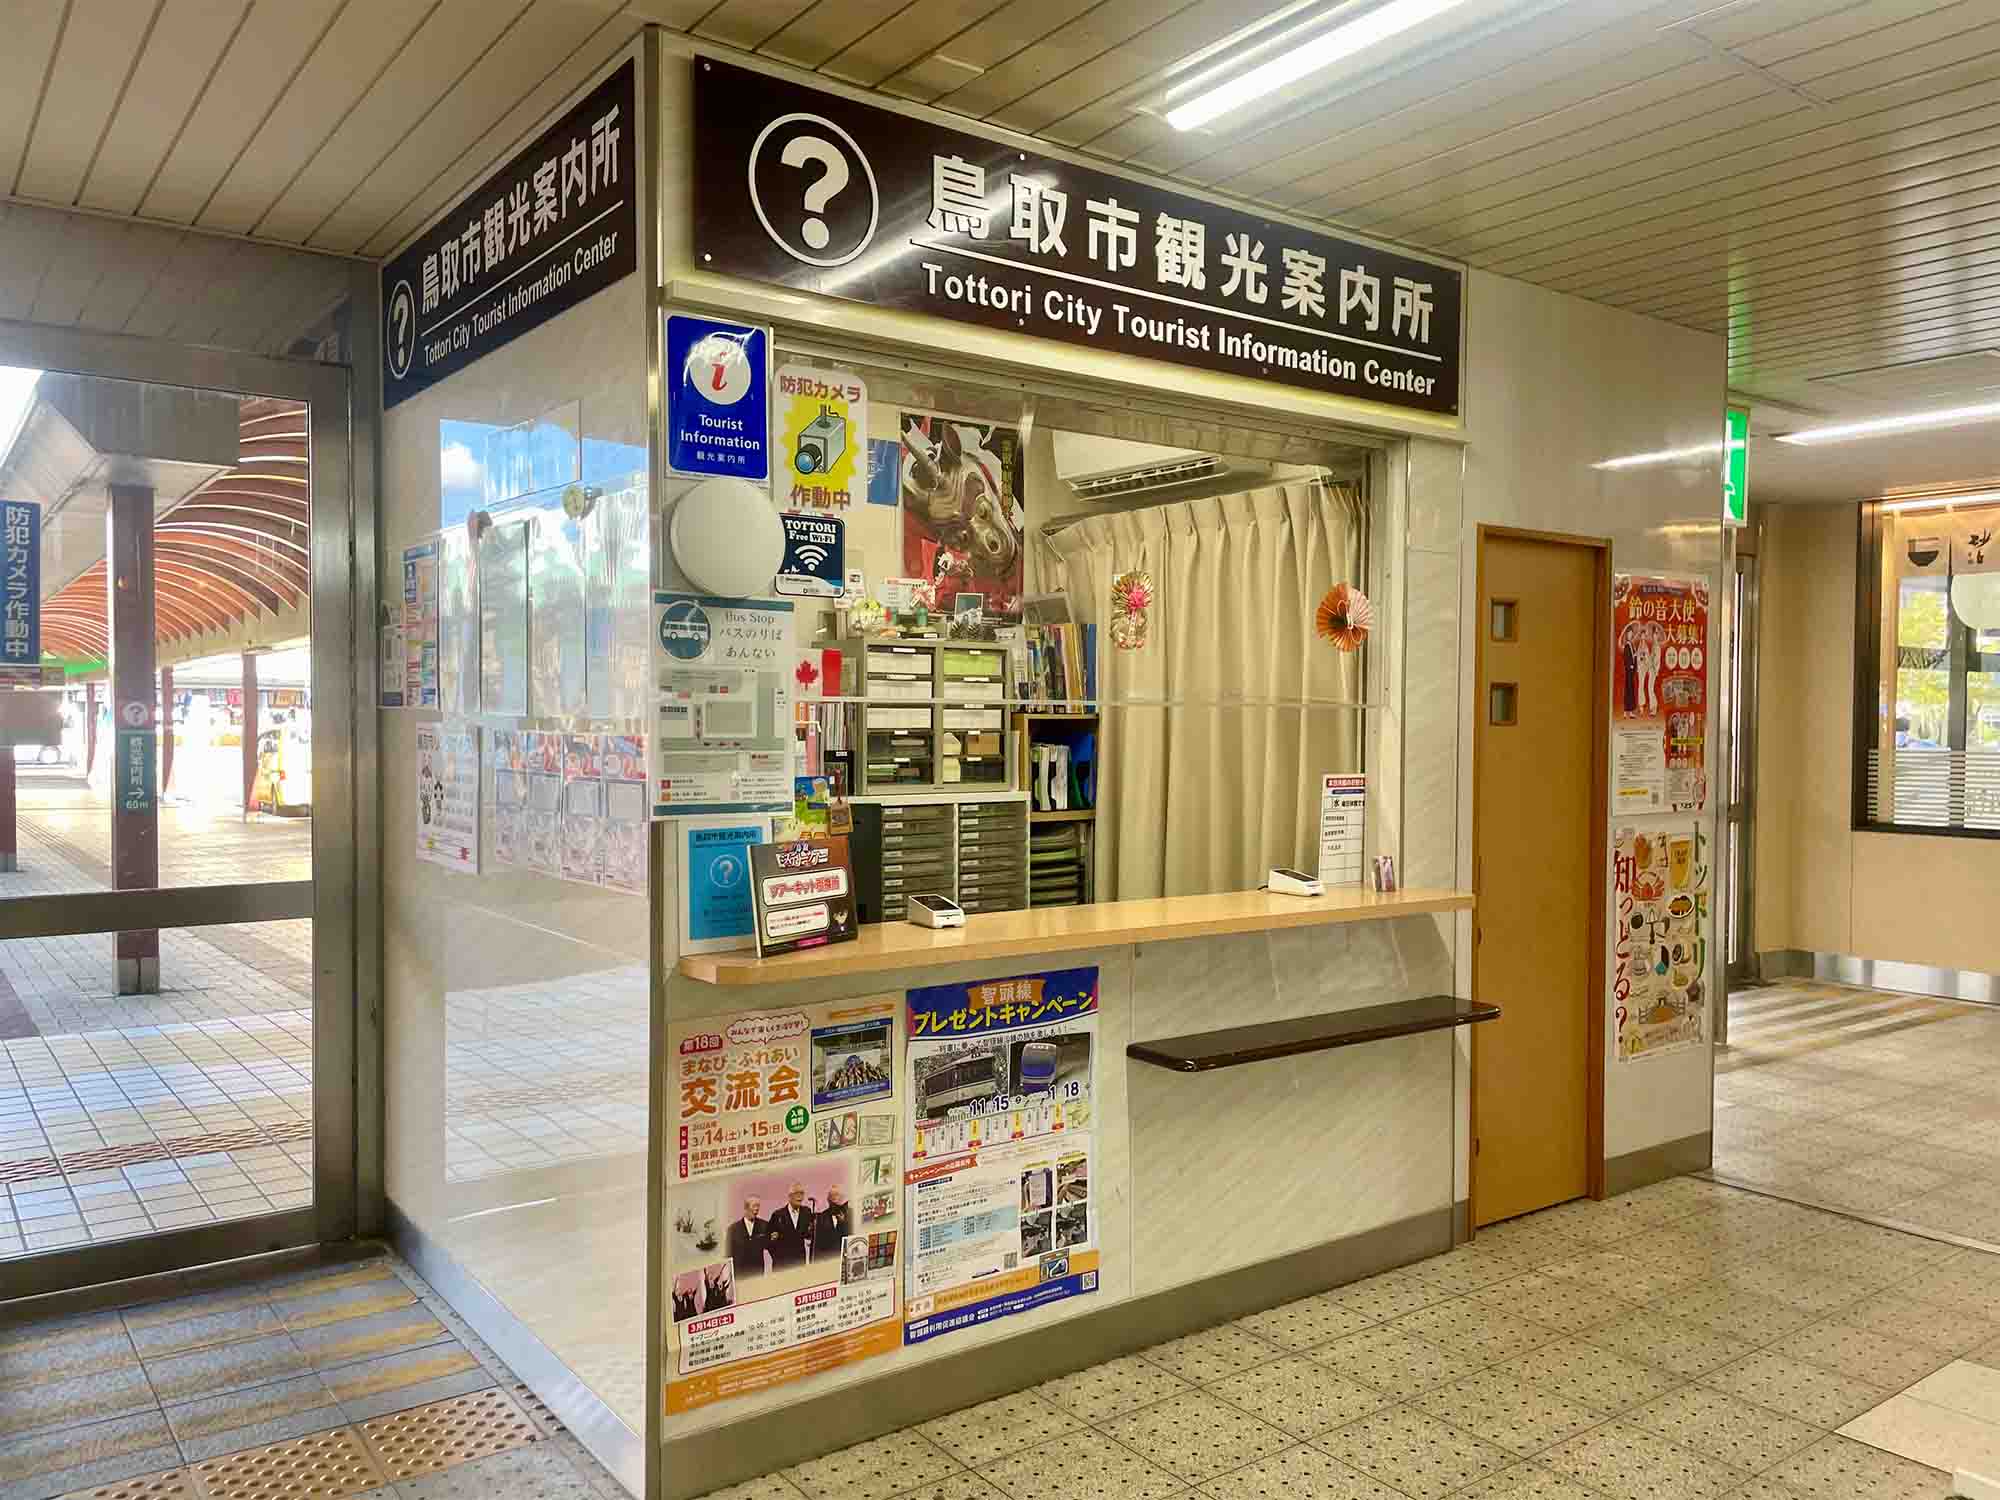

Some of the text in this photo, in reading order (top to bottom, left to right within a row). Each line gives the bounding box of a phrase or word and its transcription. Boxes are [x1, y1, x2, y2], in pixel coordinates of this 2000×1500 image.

[422, 103, 621, 314] 鳥取市観光案内所
[927, 154, 1434, 344] 鳥取市観光案内所
[424, 232, 618, 367] Tottori City Tourist Information Center
[922, 262, 1435, 396] Tottori City Tourist Information Center
[780, 375, 861, 402] 防犯カメラ
[699, 414, 743, 431] Tourist
[680, 431, 760, 450] Information
[697, 452, 746, 464] 観光案内所
[790, 484, 851, 510] 作動中
[785, 519, 837, 533] TOTTORI
[789, 530, 809, 541] Free
[5, 506, 31, 658] 防犯カメラ作動中
[725, 612, 775, 625] Bus Stop
[720, 629, 782, 641] バスのりば
[726, 648, 776, 658] あんない
[982, 981, 1033, 1006] 智頭線
[913, 991, 1094, 1035] プレゼントキャンペーン
[681, 1065, 800, 1118] 交流会
